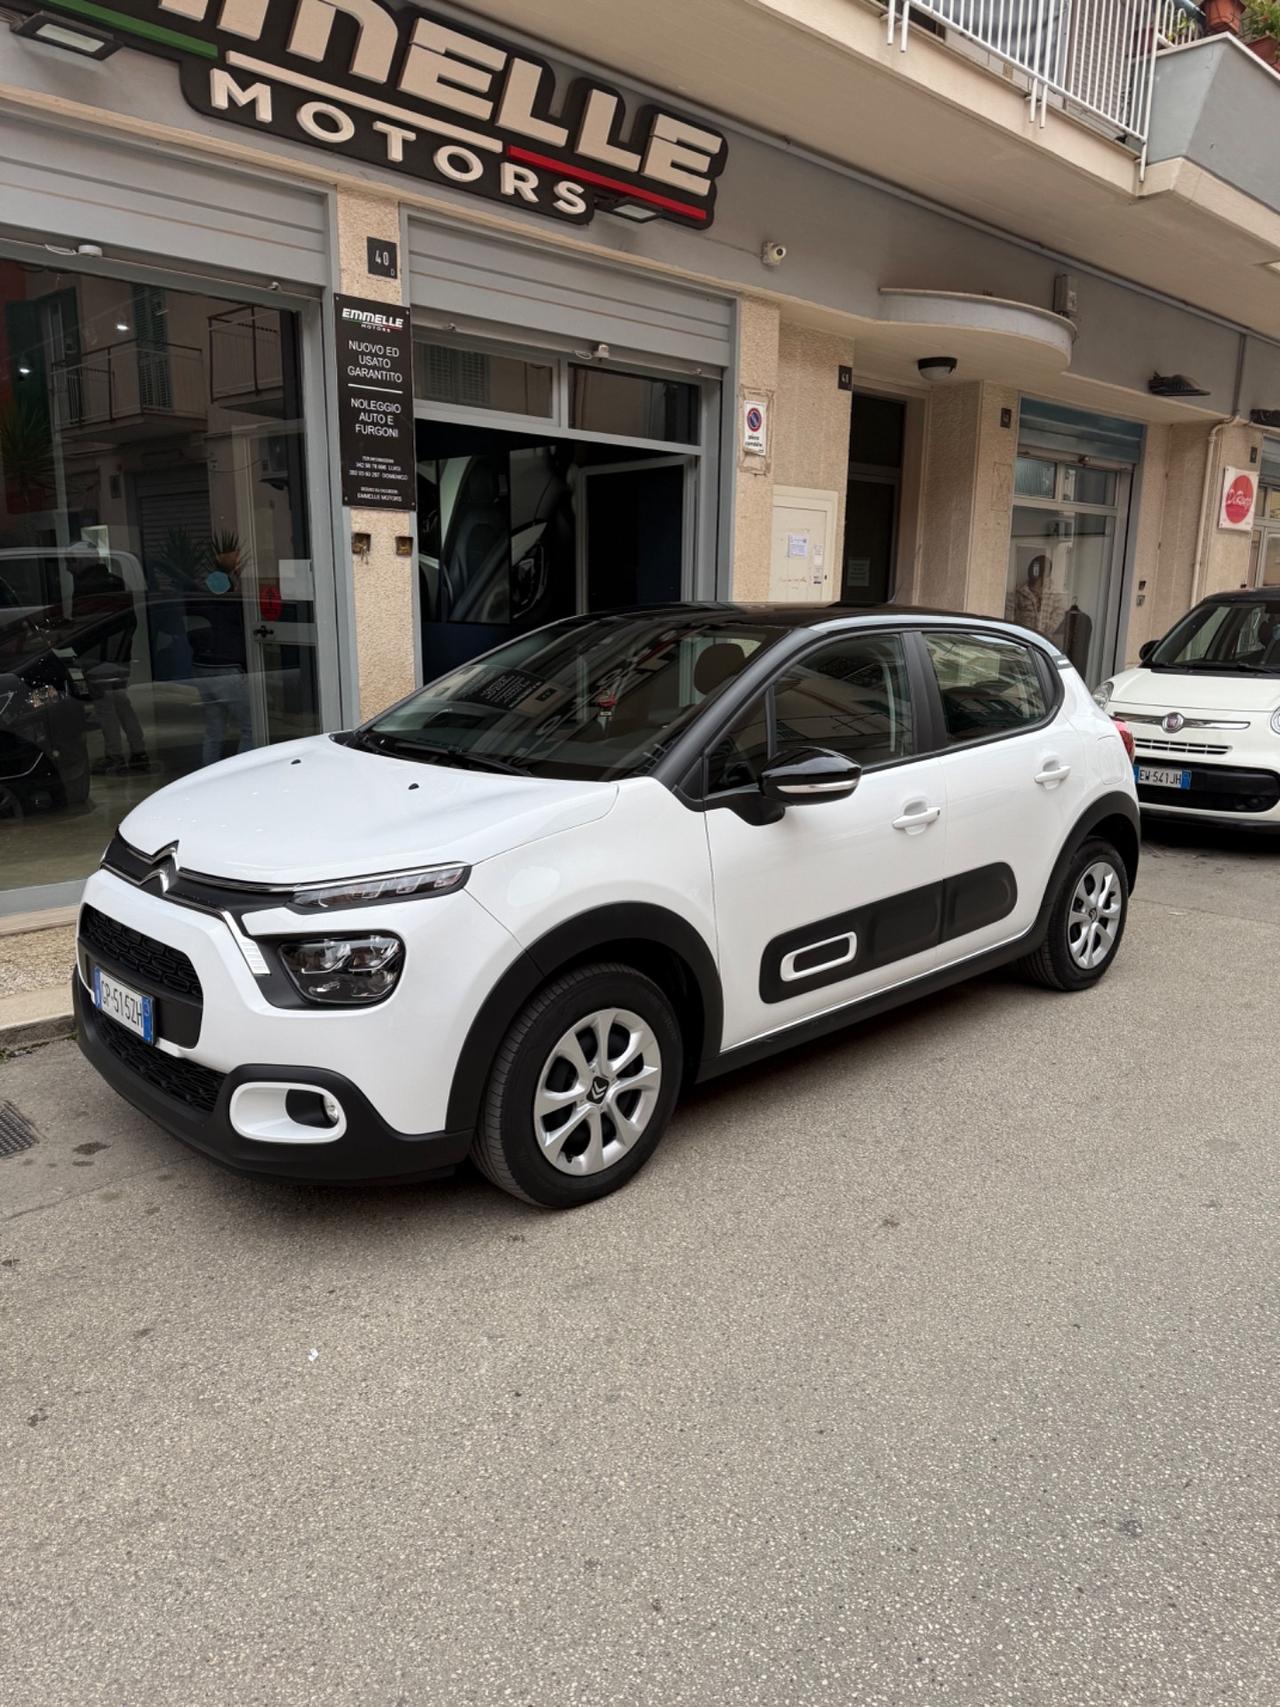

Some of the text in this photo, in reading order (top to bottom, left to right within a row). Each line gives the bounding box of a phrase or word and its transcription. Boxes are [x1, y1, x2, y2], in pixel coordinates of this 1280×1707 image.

[210, 68, 588, 217] MOTORS
[375, 250, 389, 266] 40
[342, 307, 404, 328] EMMELLE
[361, 323, 391, 333] MOTORS
[348, 340, 400, 357] NUOVO ED
[358, 354, 391, 369] USATO
[347, 365, 403, 383] GARANTITO
[350, 398, 401, 414] NOLEGGIO
[359, 412, 394, 425] AUTO E
[355, 423, 399, 438] FURGONI
